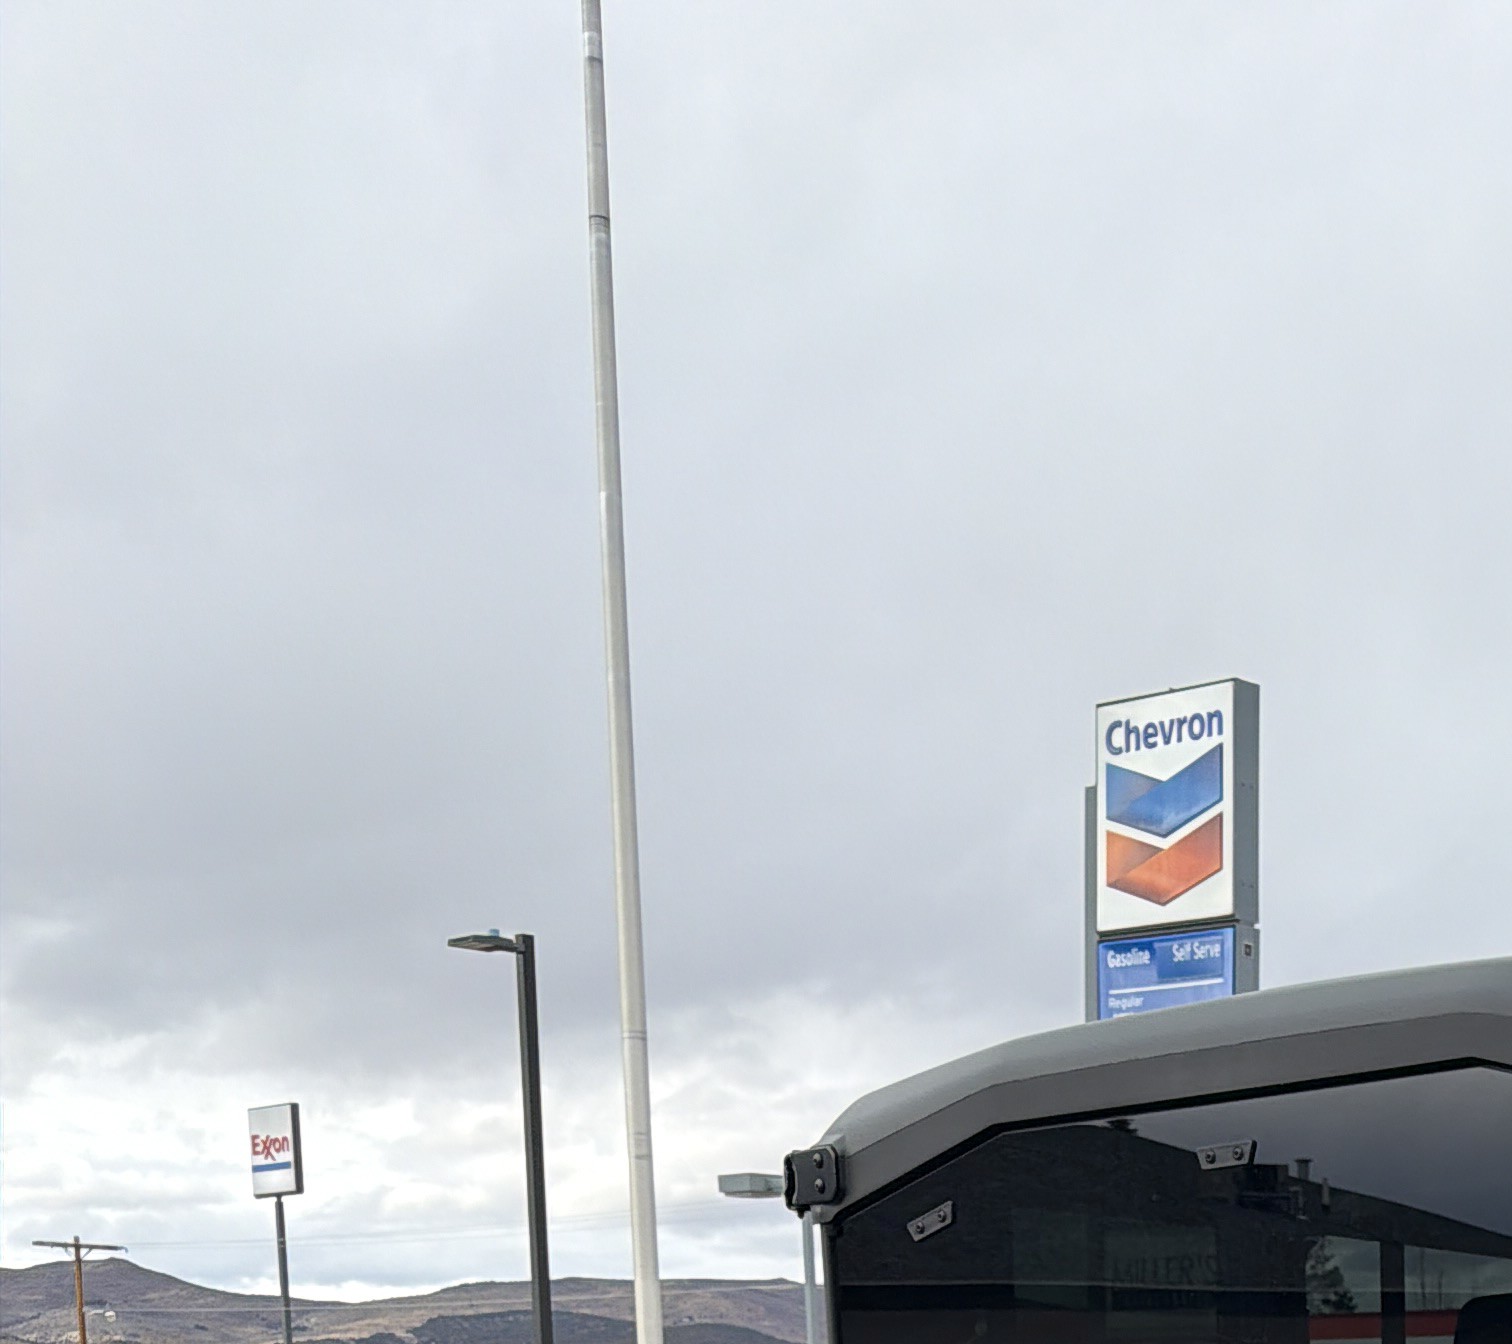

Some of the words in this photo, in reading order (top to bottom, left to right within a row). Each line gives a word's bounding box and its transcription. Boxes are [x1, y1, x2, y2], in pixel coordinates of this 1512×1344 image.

[1105, 709, 1223, 756] Chevron
[1107, 947, 1150, 968] Gasoline
[1172, 941, 1191, 962] Self
[1193, 941, 1221, 960] Serve
[251, 1134, 290, 1161] Exxon
